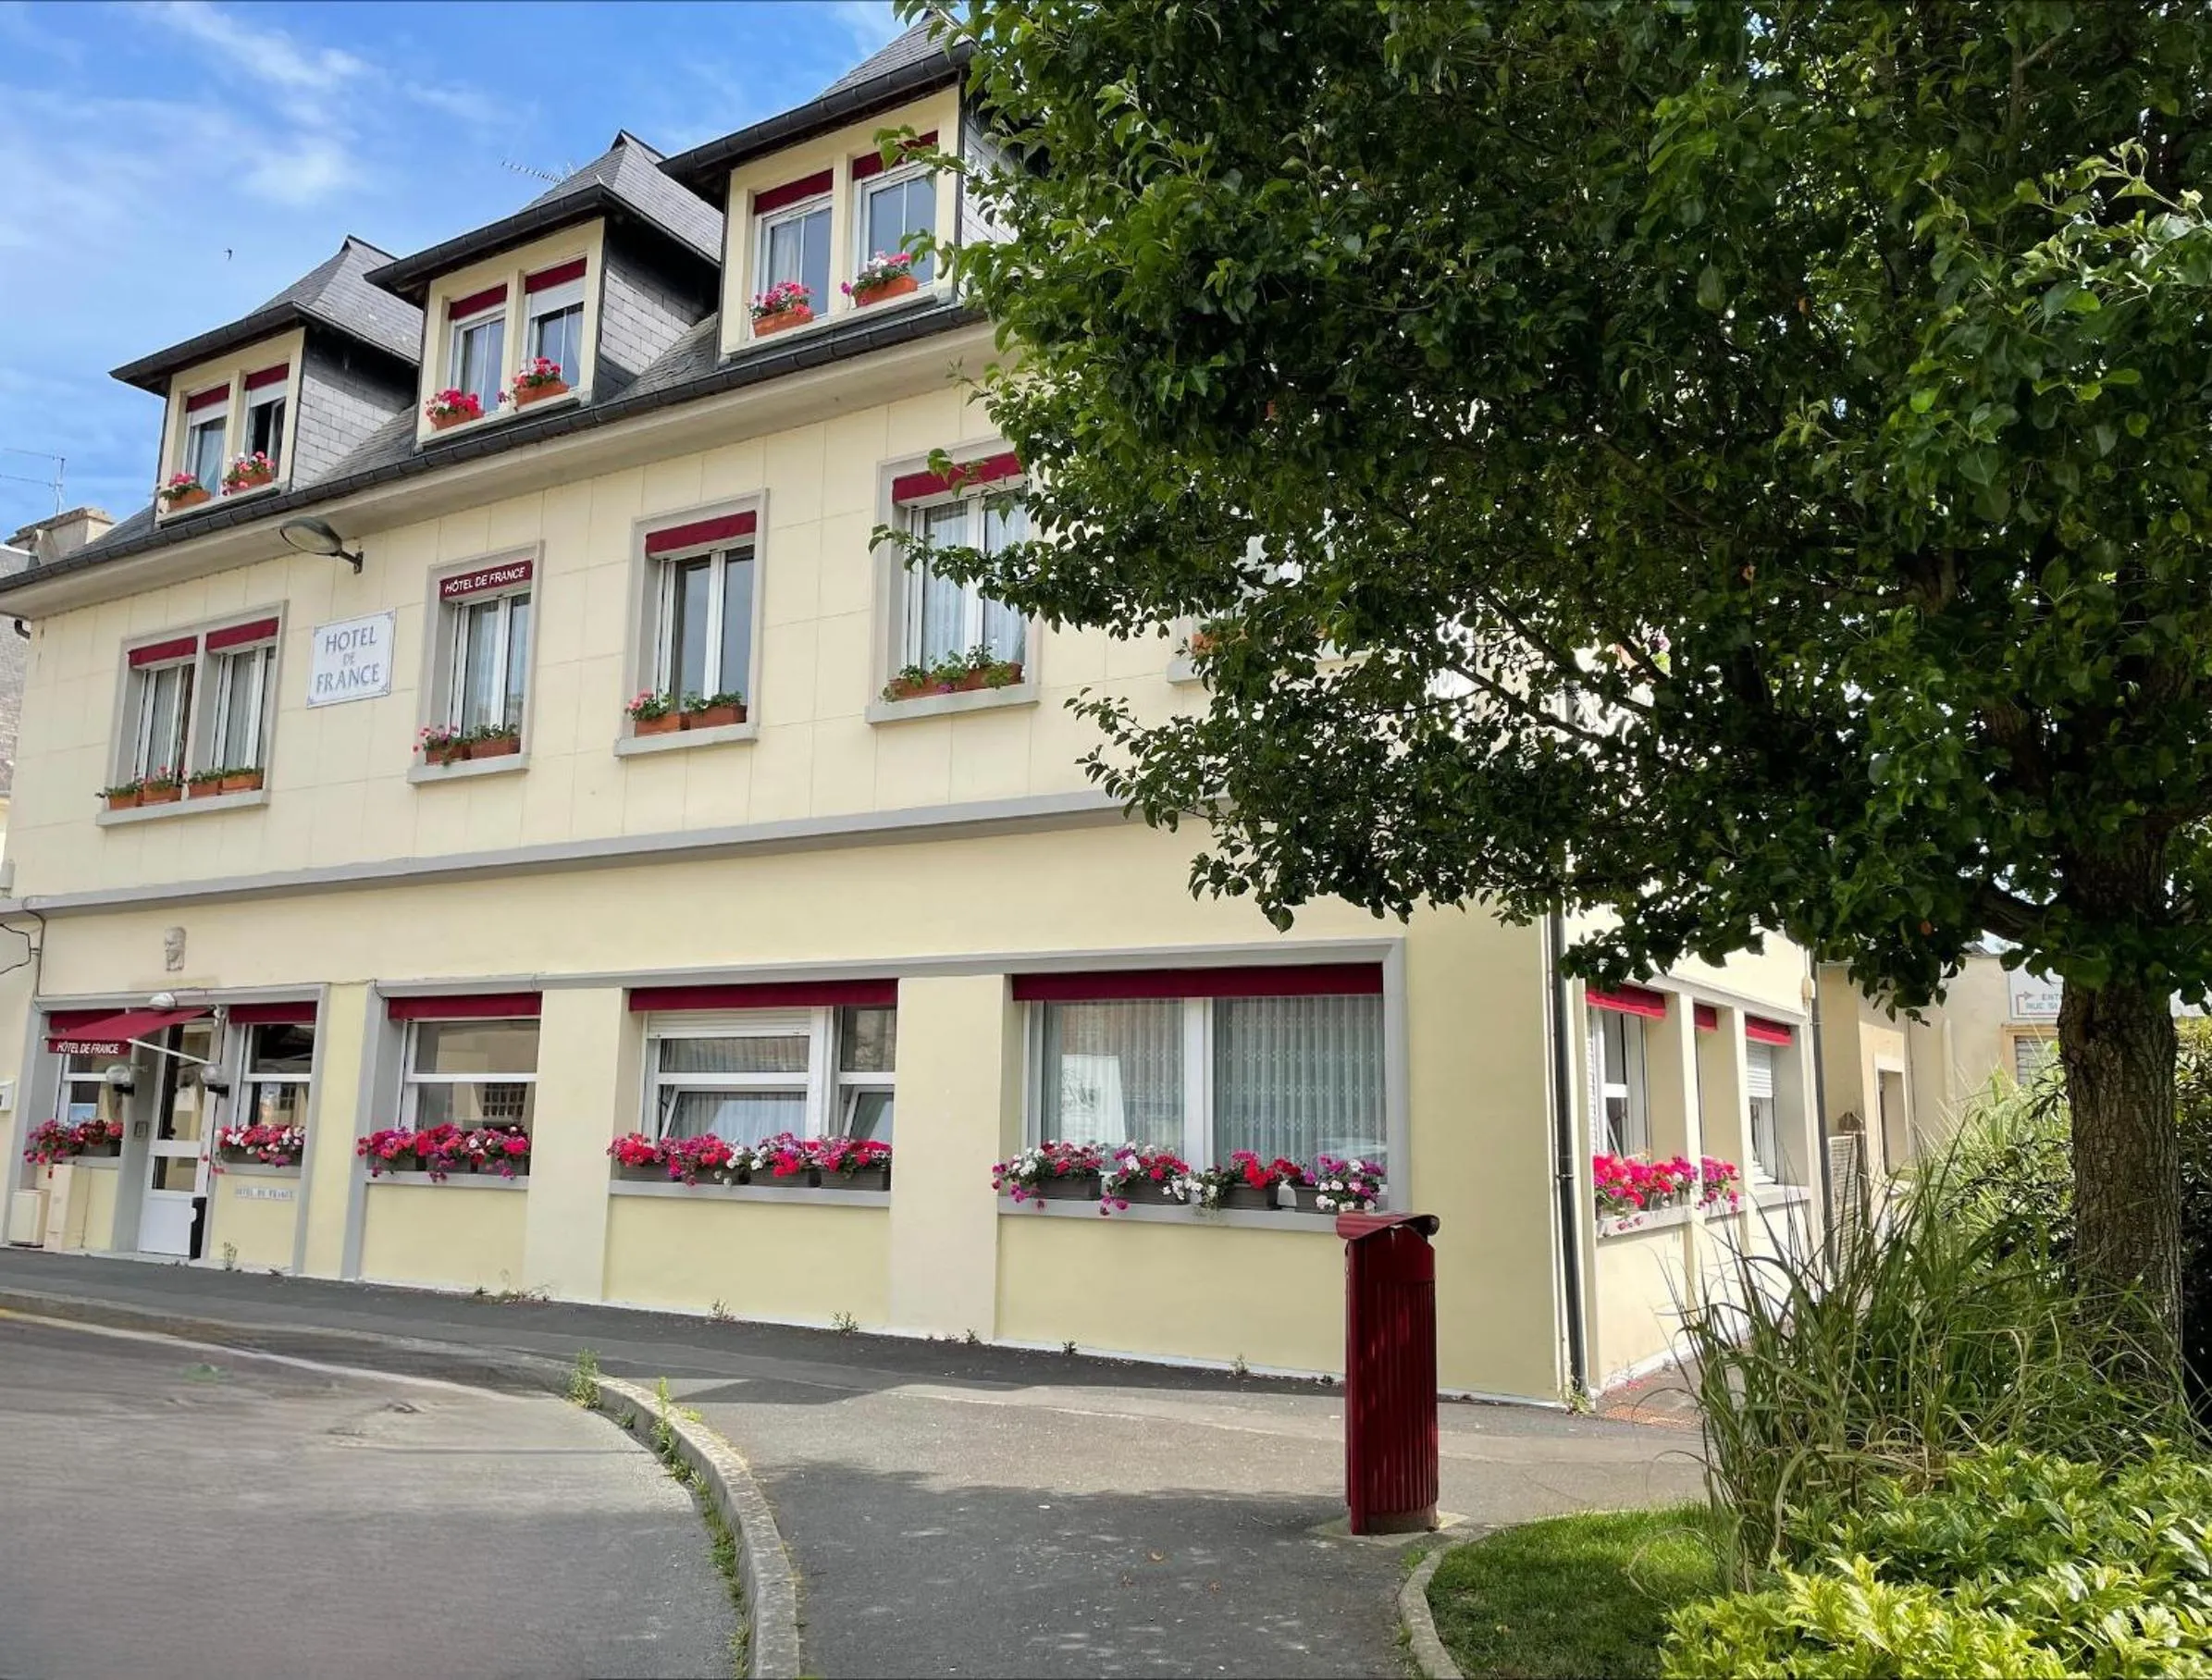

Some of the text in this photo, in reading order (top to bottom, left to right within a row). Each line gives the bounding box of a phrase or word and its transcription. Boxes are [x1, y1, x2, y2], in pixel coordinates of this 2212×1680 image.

[445, 566, 525, 593] HÔTEL DE FRANCE
[326, 625, 377, 653] HOTEL
[342, 651, 356, 667] DE
[316, 661, 380, 694] FRANCE
[80, 1044, 90, 1054] DE
[92, 1043, 118, 1054] FRANCE
